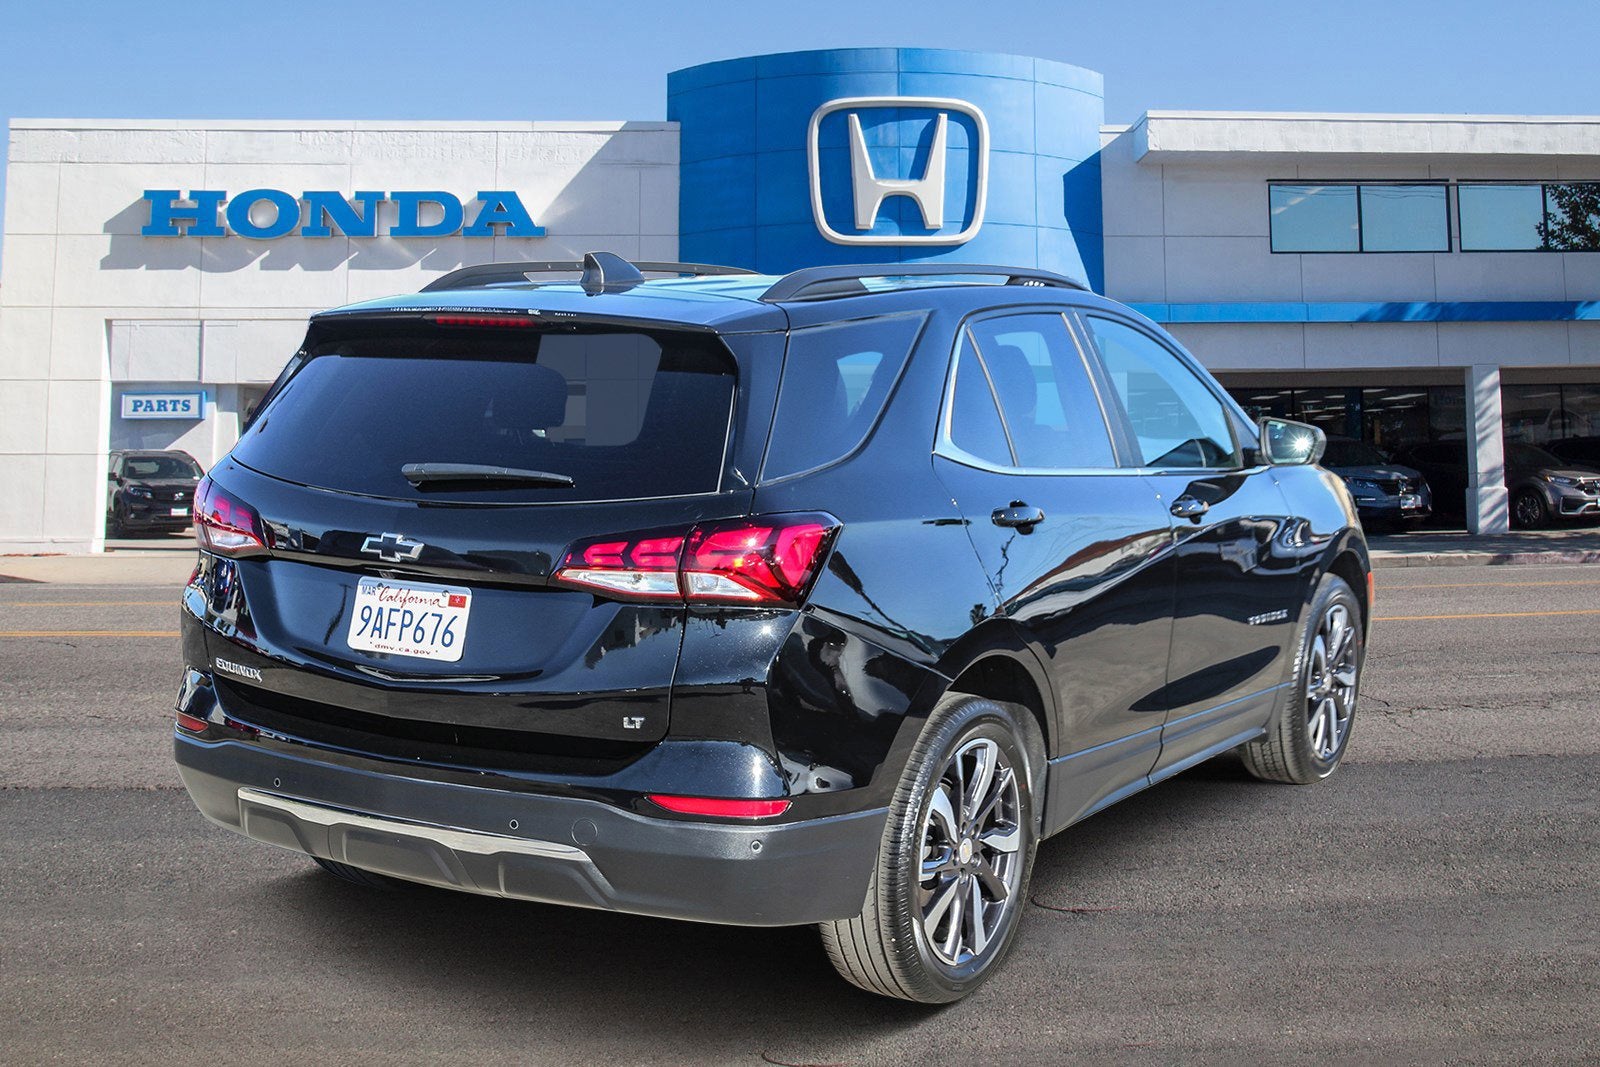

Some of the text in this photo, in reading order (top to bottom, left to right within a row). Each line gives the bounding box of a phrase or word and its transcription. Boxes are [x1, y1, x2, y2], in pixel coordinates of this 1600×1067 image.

[141, 189, 547, 239] HONDA
[132, 400, 191, 412] PARTS
[379, 586, 447, 609] California
[357, 605, 458, 648] 9AFP676
[374, 643, 431, 655] dmv.ca.gov
[622, 716, 645, 729] LT
